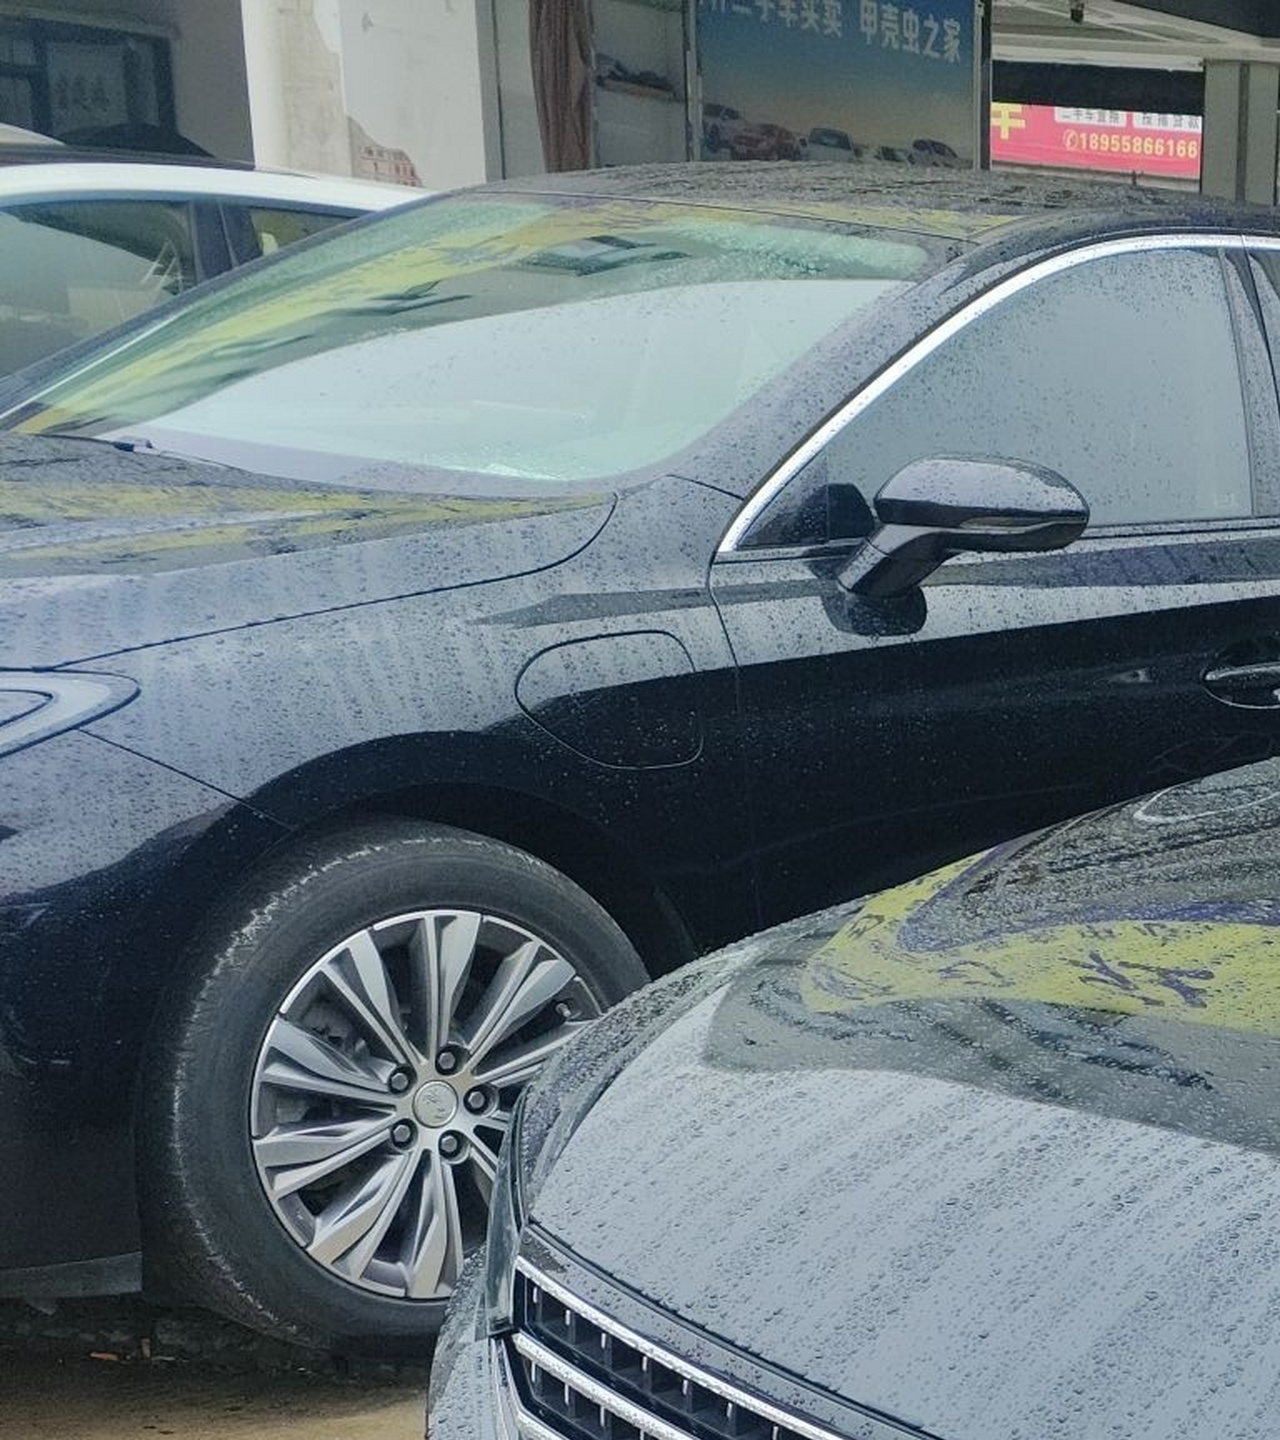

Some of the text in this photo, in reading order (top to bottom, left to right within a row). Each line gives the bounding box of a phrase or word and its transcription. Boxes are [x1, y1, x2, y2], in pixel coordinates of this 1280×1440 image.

[859, 1, 960, 63] 甲壳虫之家
[1079, 131, 1199, 158] 18955866166
